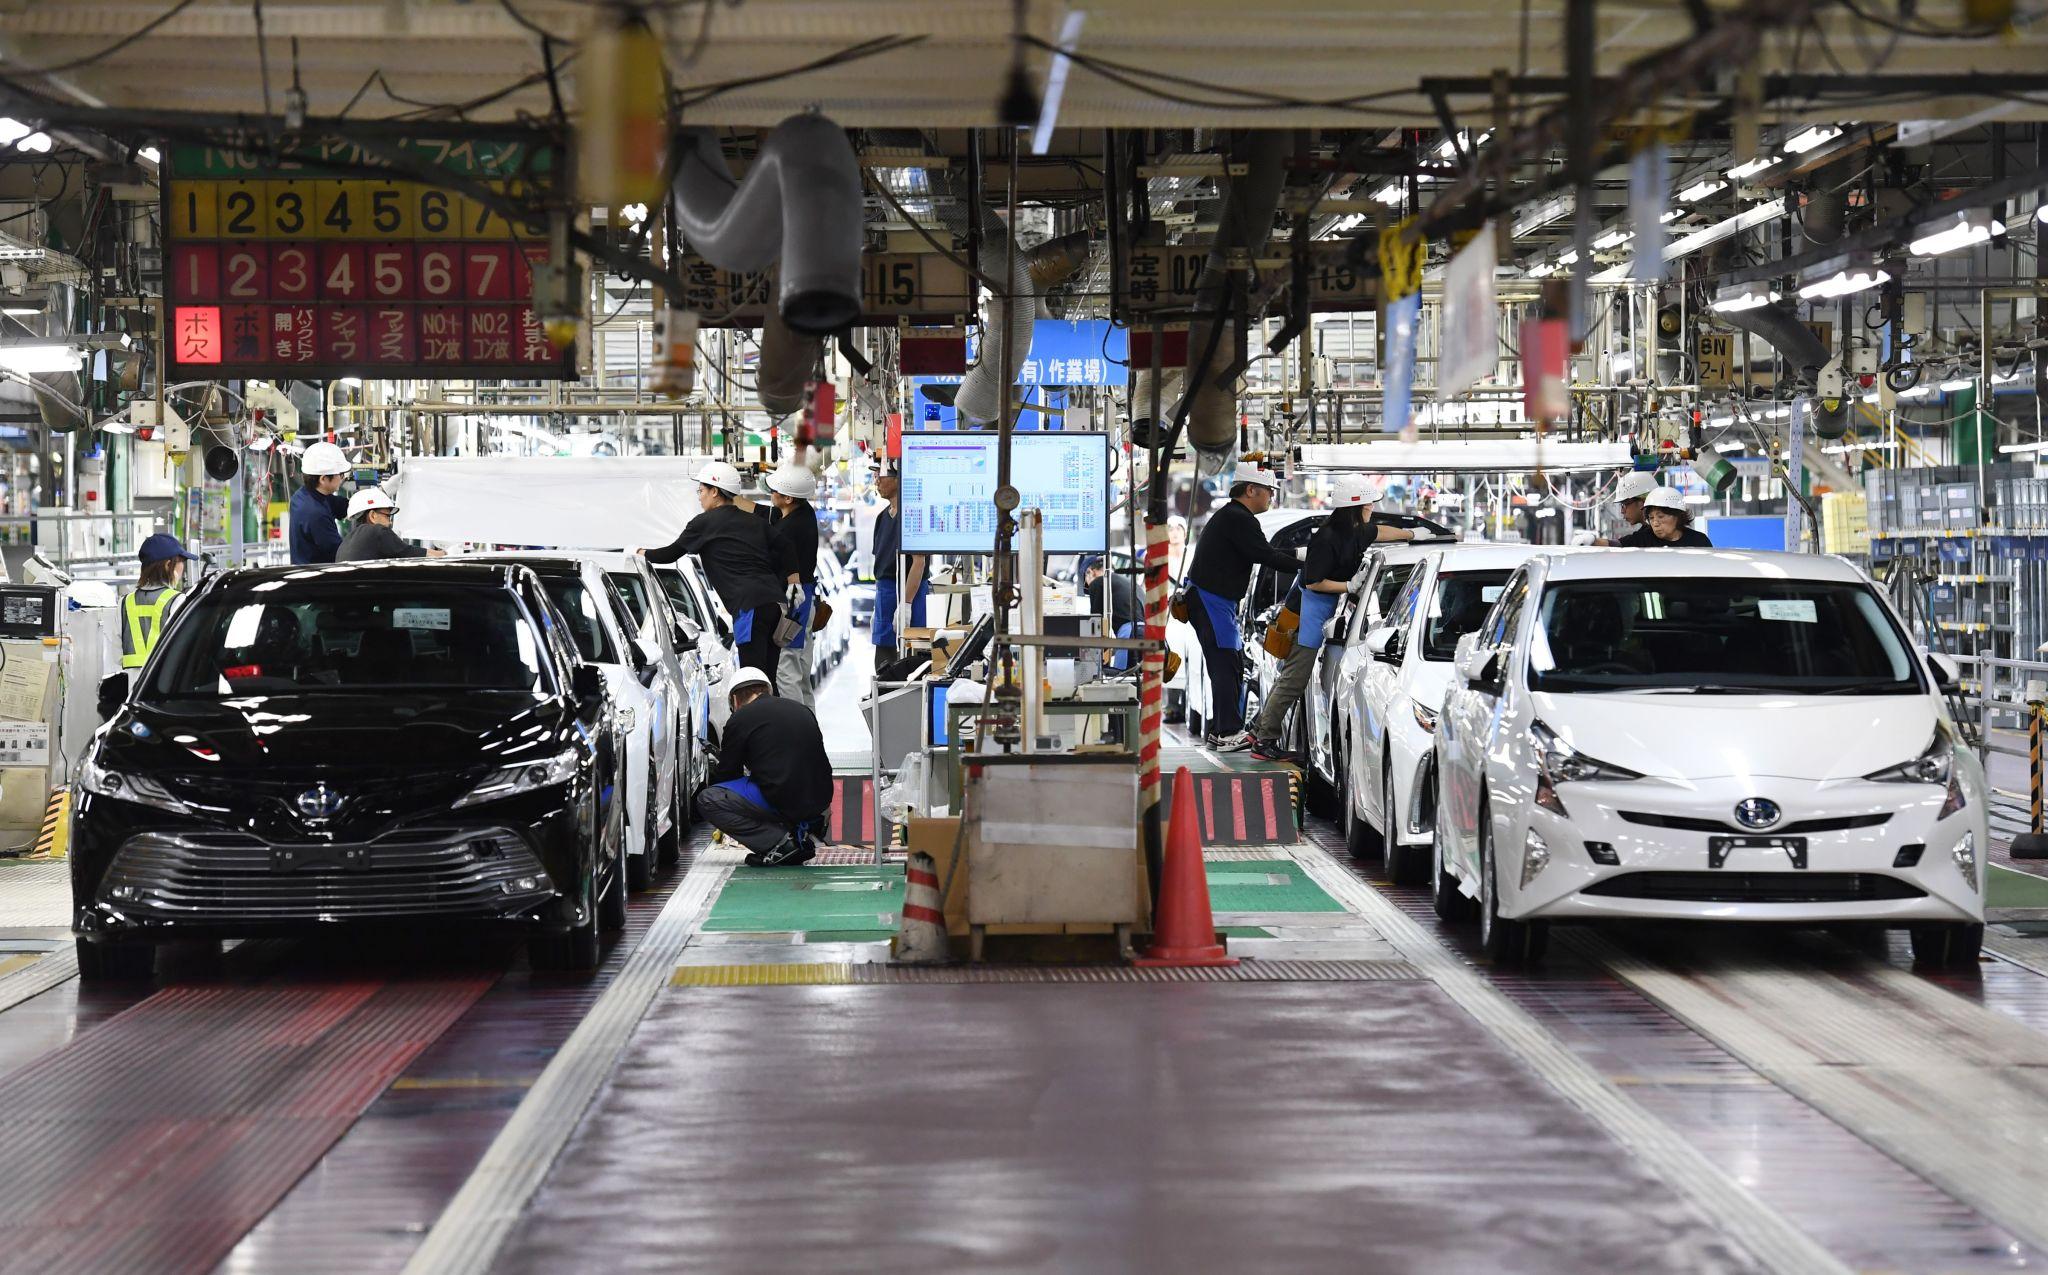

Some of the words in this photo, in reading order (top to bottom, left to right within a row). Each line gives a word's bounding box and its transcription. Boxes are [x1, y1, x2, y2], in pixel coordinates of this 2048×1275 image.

[188, 191, 197, 233] 1
[227, 191, 255, 233] 2
[276, 191, 304, 234] 3
[324, 191, 351, 233] 4
[373, 191, 401, 233] 5
[420, 191, 448, 233] 6
[189, 253, 198, 296] 1
[229, 253, 257, 296] 2
[278, 250, 307, 293] 3
[327, 254, 354, 296] 4
[374, 253, 402, 296] 5
[423, 253, 451, 296] 6
[469, 254, 498, 297] 7
[879, 263, 914, 305] 1.5
[1130, 253, 1159, 301] 定時
